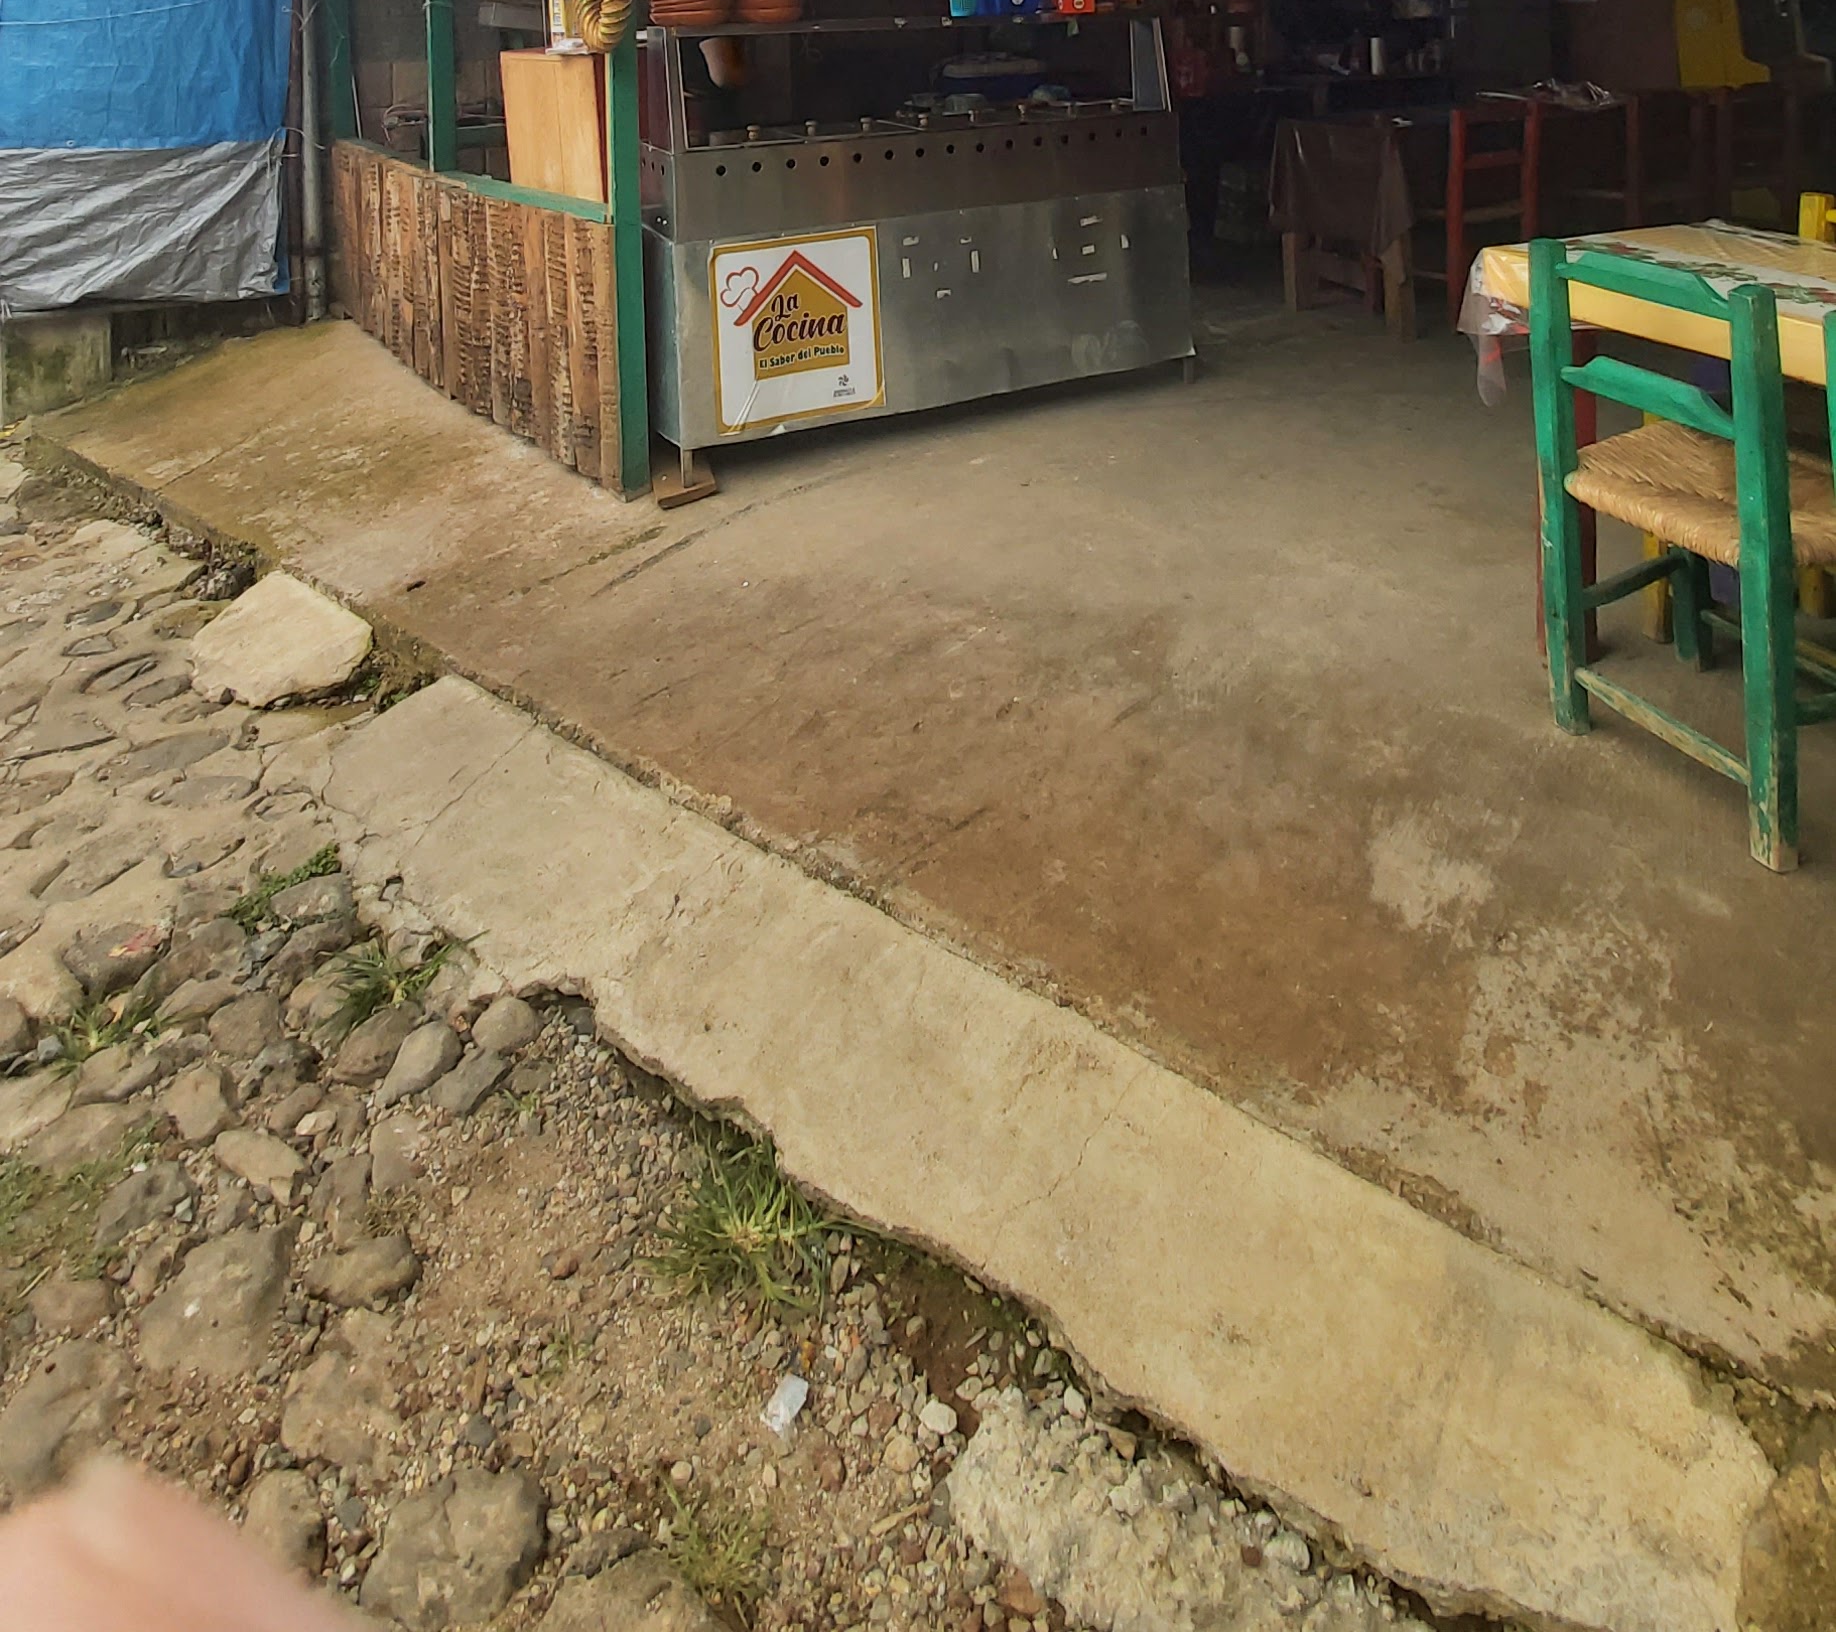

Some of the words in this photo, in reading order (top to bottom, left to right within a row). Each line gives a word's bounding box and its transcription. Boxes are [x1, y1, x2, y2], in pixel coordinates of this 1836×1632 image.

[771, 294, 799, 321] La
[753, 312, 846, 352] Cocina
[759, 359, 768, 368] El
[769, 353, 796, 367] Sabor
[798, 350, 812, 360] del
[813, 345, 845, 356] Pueblo
